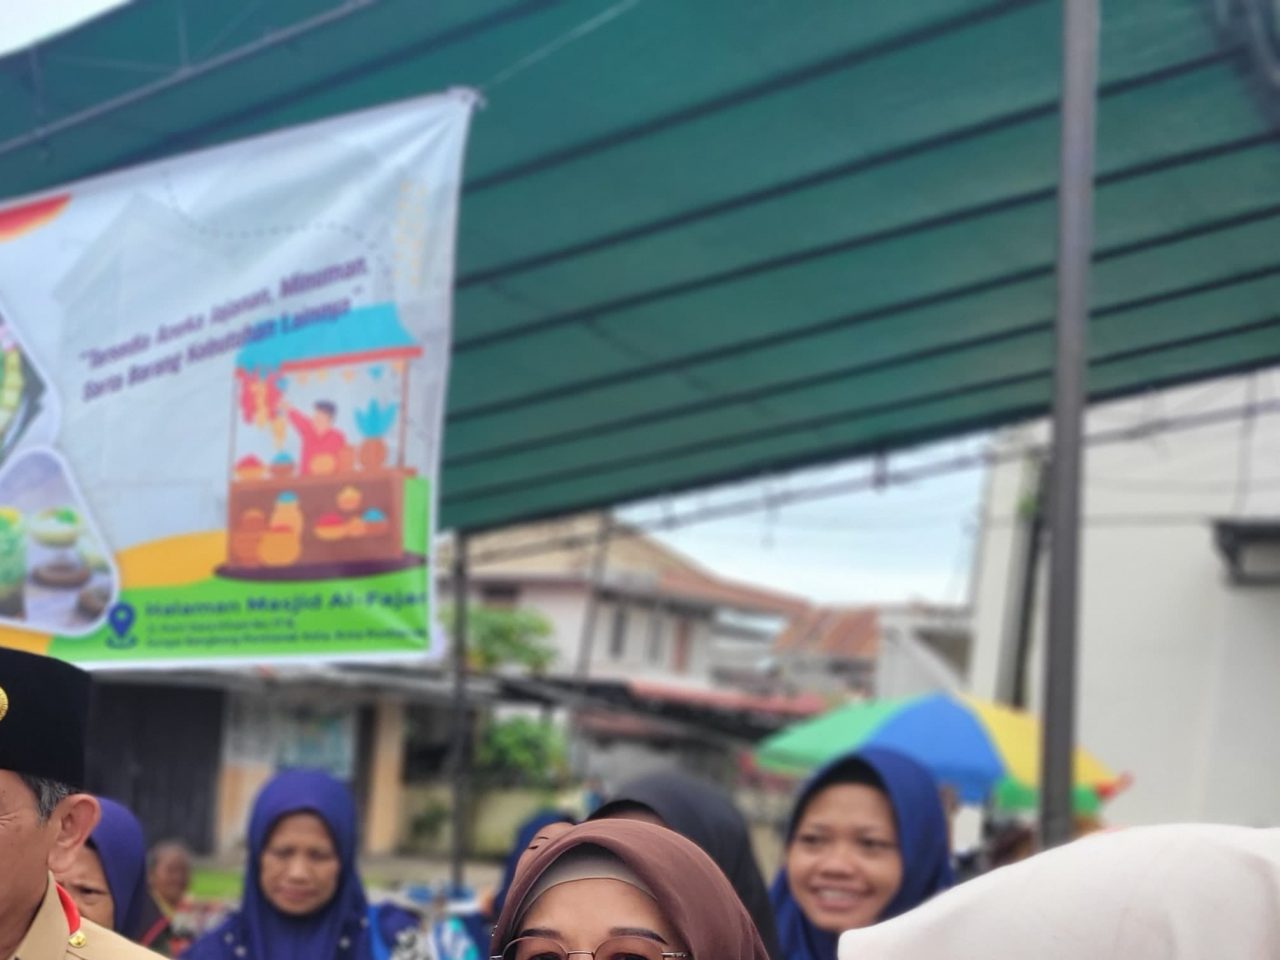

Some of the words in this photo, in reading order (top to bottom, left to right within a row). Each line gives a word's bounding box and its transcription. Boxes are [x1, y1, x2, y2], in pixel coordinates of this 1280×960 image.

[127, 352, 182, 387] Barang
[187, 318, 277, 363] Kebutuhan
[146, 601, 240, 618] Halaman
[247, 593, 324, 614] Masjid
